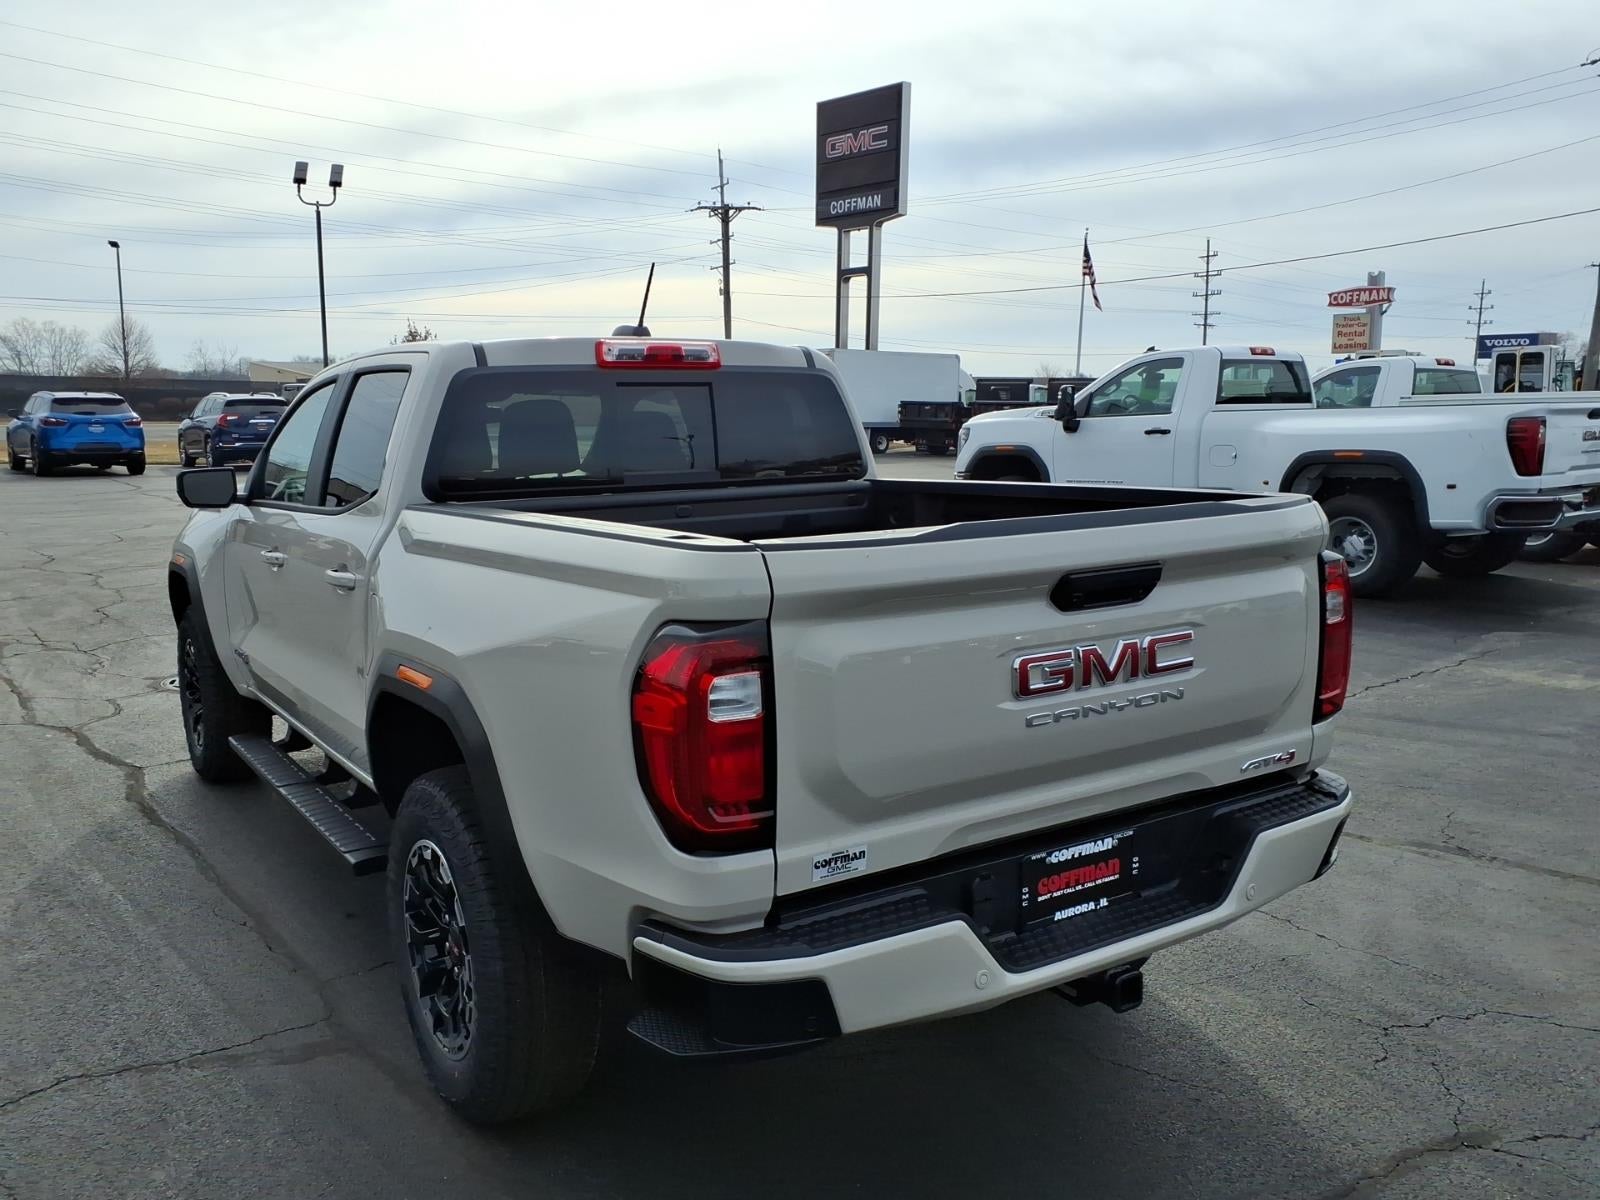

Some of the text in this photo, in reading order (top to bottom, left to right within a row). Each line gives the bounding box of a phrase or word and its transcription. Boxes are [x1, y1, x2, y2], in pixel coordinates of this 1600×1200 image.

[826, 125, 888, 158] GMC
[830, 194, 881, 214] COFFMAN
[1331, 289, 1388, 304] COFFMAN
[1337, 329, 1366, 338] Rental
[1485, 338, 1530, 347] VOLVO
[1333, 341, 1368, 350] Leasing
[1011, 628, 1195, 700] GMC
[1025, 687, 1185, 728] CANYON
[814, 850, 866, 870] COFFMAN
[1050, 837, 1113, 864] COFFMAN
[827, 862, 852, 874] GMC
[1038, 858, 1120, 895] COFFMAN
[1054, 901, 1096, 921] AURORA
